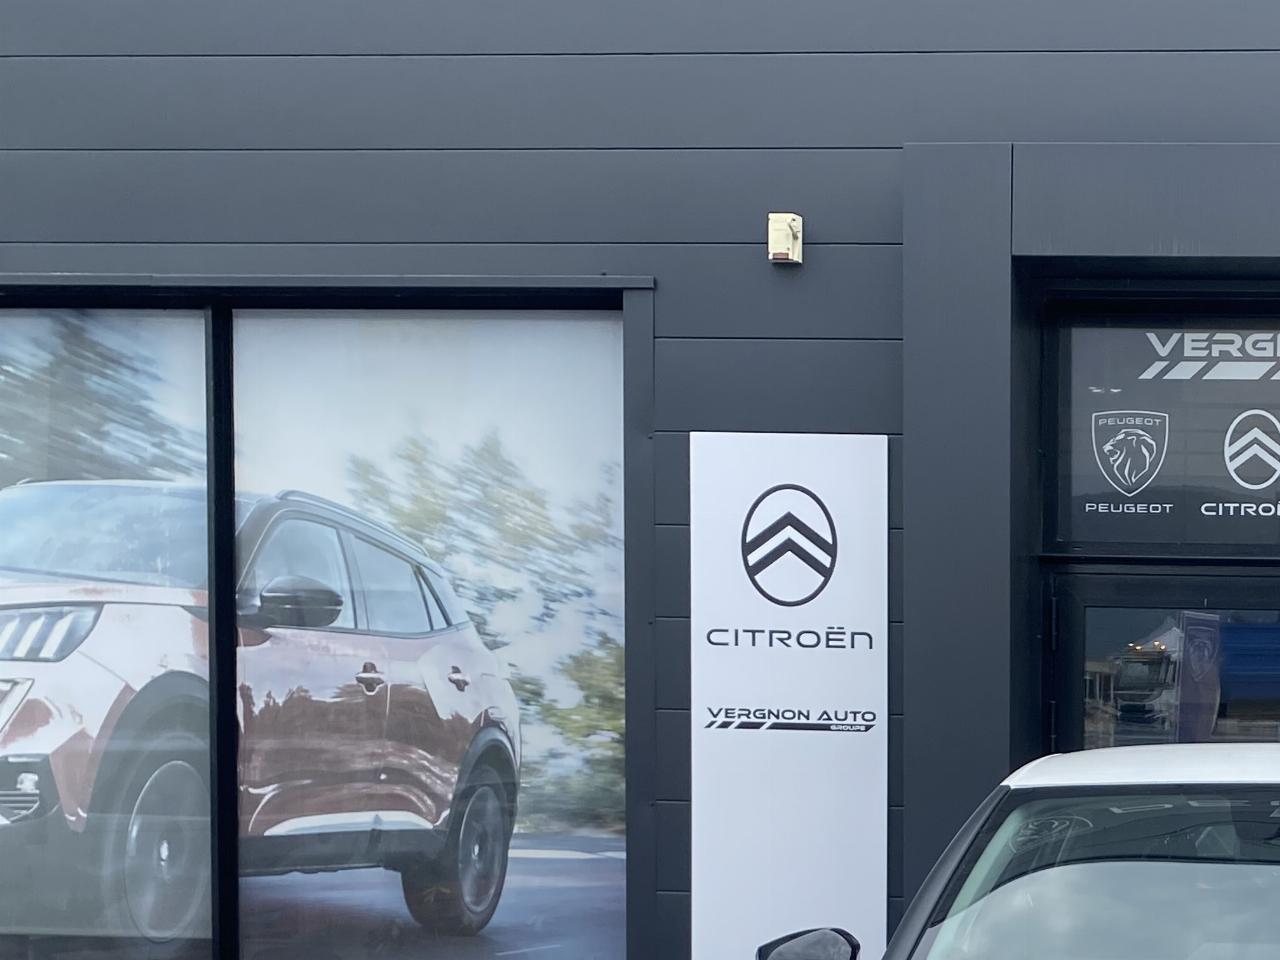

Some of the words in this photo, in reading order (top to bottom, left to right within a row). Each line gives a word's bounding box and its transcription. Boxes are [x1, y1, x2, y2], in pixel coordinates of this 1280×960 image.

[1098, 417, 1162, 427] PEUGEOT
[1085, 503, 1174, 514] PEUGEOT
[707, 707, 810, 721] VERGNON
[817, 710, 876, 722] AUTO
